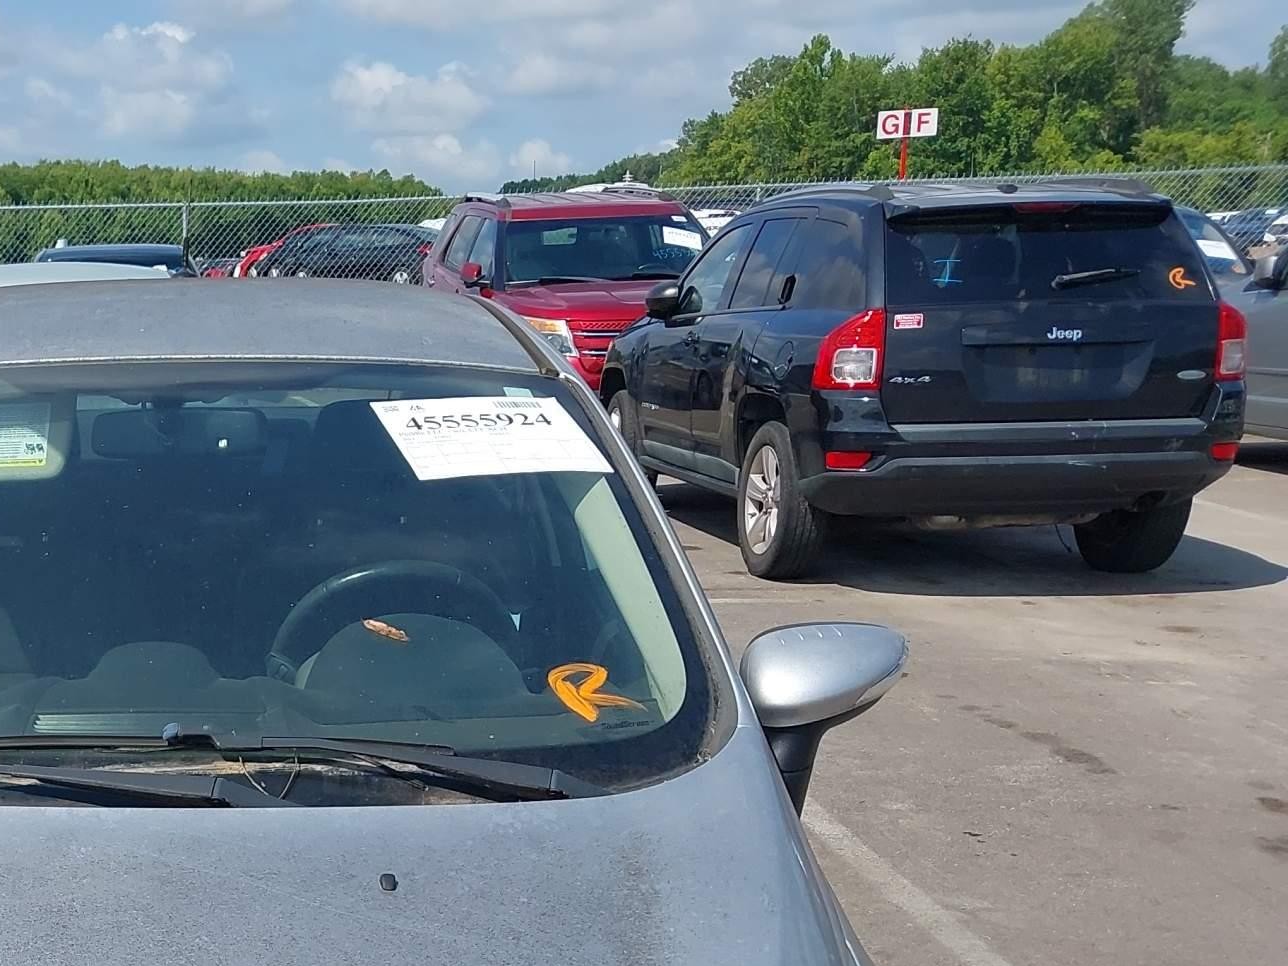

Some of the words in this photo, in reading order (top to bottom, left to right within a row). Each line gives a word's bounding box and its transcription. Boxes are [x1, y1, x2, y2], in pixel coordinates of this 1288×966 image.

[882, 114, 899, 135] G
[917, 112, 932, 132] F
[1047, 326, 1082, 341] Jeep
[406, 412, 553, 431] 45555924
[547, 661, 649, 723] R
